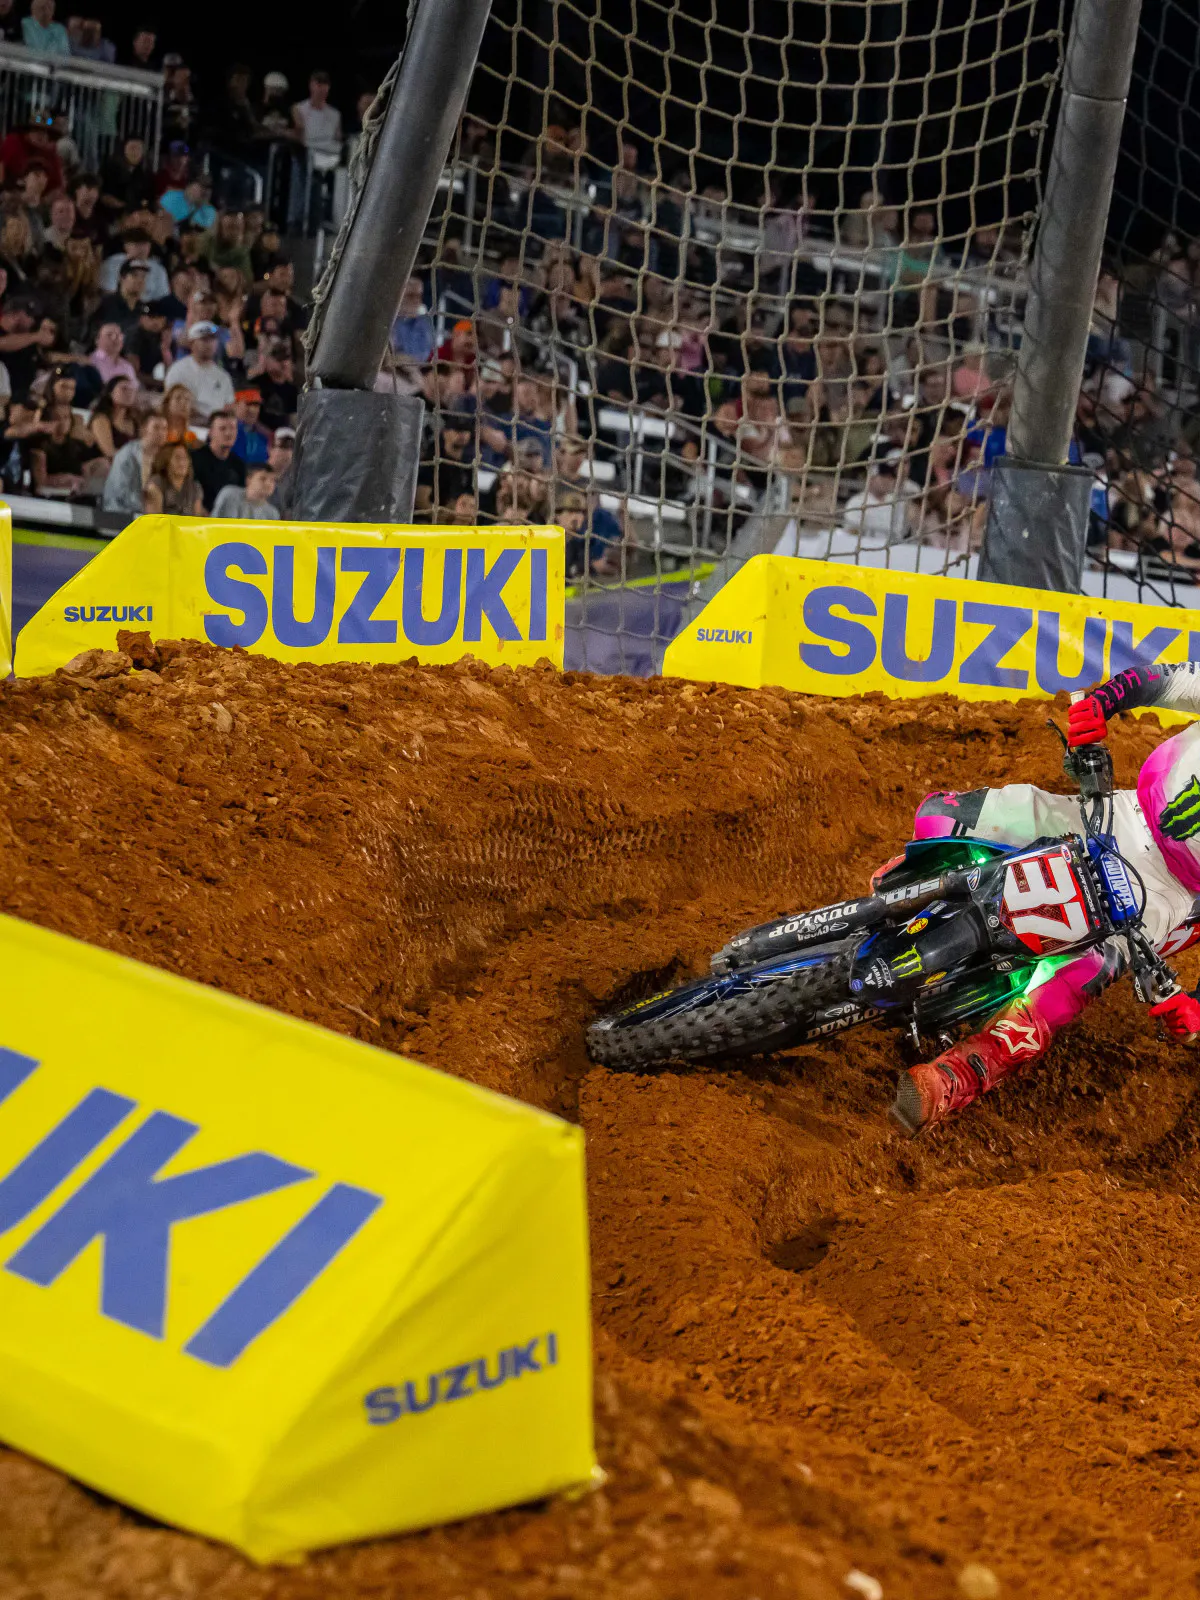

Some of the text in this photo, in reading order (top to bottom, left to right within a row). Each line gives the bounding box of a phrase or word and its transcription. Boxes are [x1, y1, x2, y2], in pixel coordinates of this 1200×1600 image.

[64, 605, 152, 623] SUZUKI
[204, 542, 548, 648] SUZUKI
[697, 627, 752, 644] SUZUKI
[769, 902, 859, 938] DUNLOP
[1002, 853, 1090, 942] 37
[363, 1333, 558, 1425] SUZUKI
